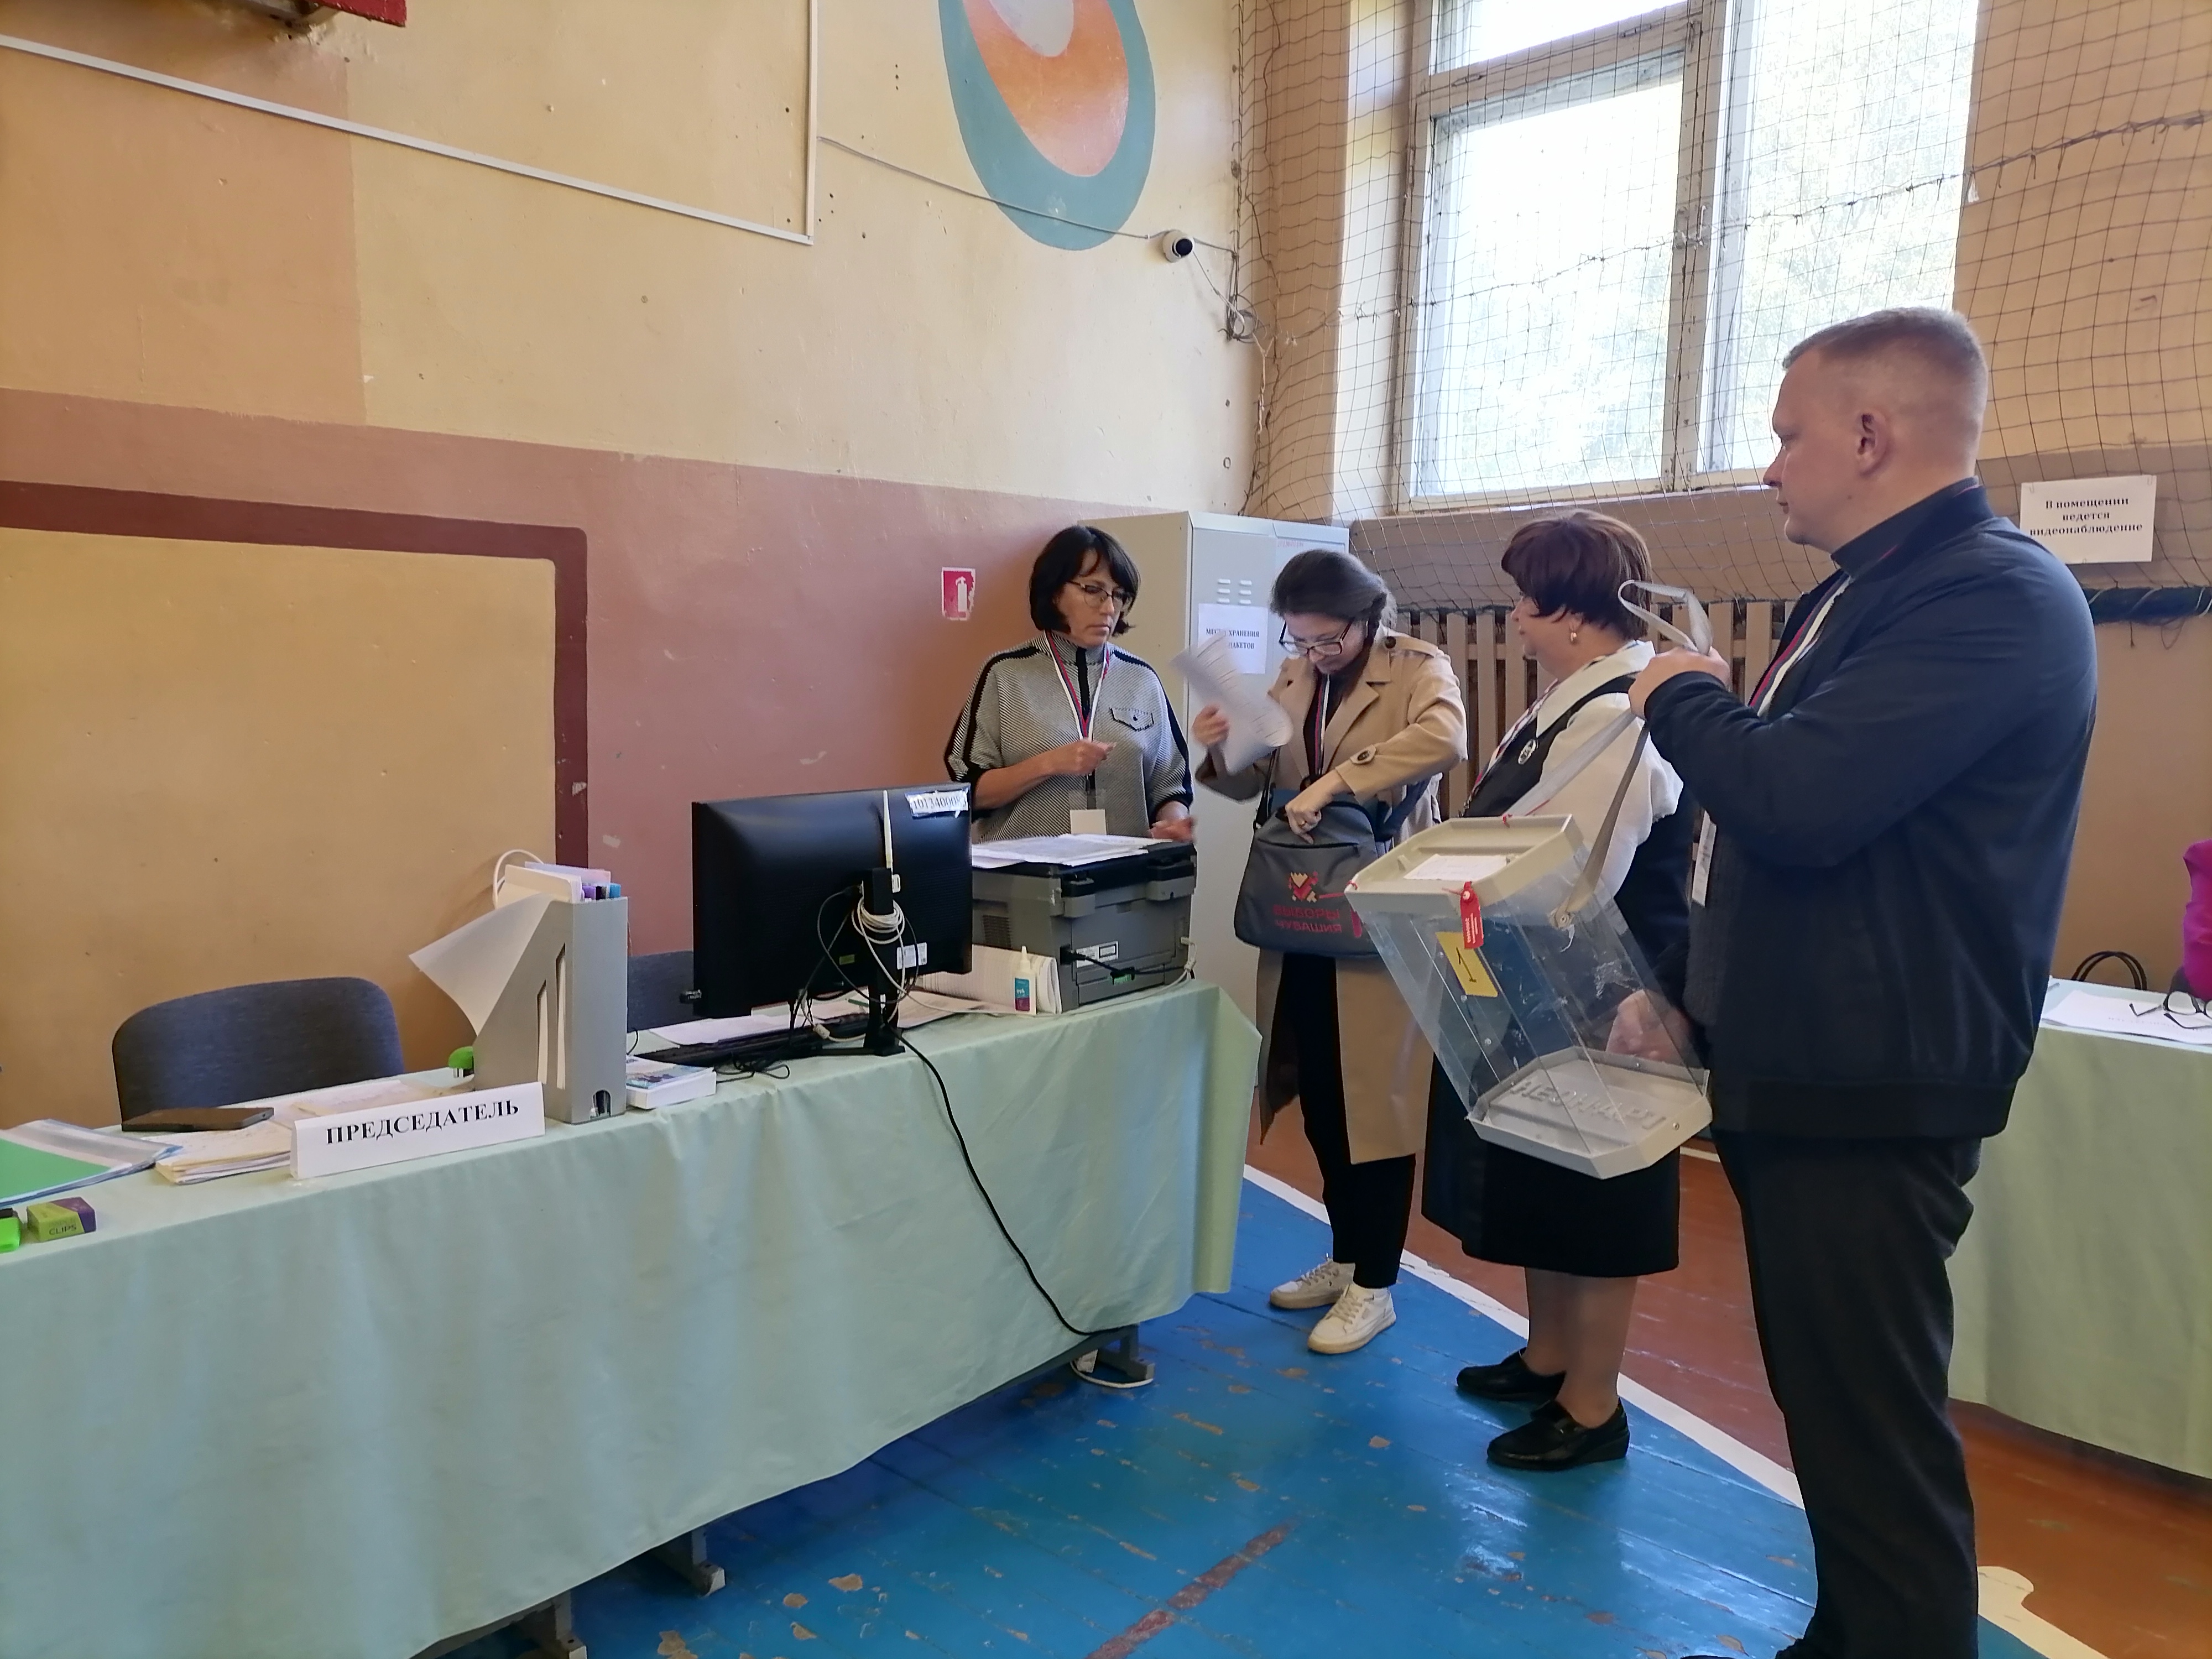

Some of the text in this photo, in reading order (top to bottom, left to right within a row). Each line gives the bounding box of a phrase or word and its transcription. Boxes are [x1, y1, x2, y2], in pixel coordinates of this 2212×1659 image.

[2056, 498, 2129, 509] помещении
[2062, 512, 2110, 523] ведется
[2029, 524, 2143, 536] видеонаблюдение
[1206, 628, 1259, 638] МЕС ХРАНЕНИЯ
[1274, 920, 1343, 933] ЧУВАШИЯ
[326, 1099, 519, 1145] ПРЕДСЕДАТЕЛЬ
[49, 1224, 77, 1235] CLIPS
